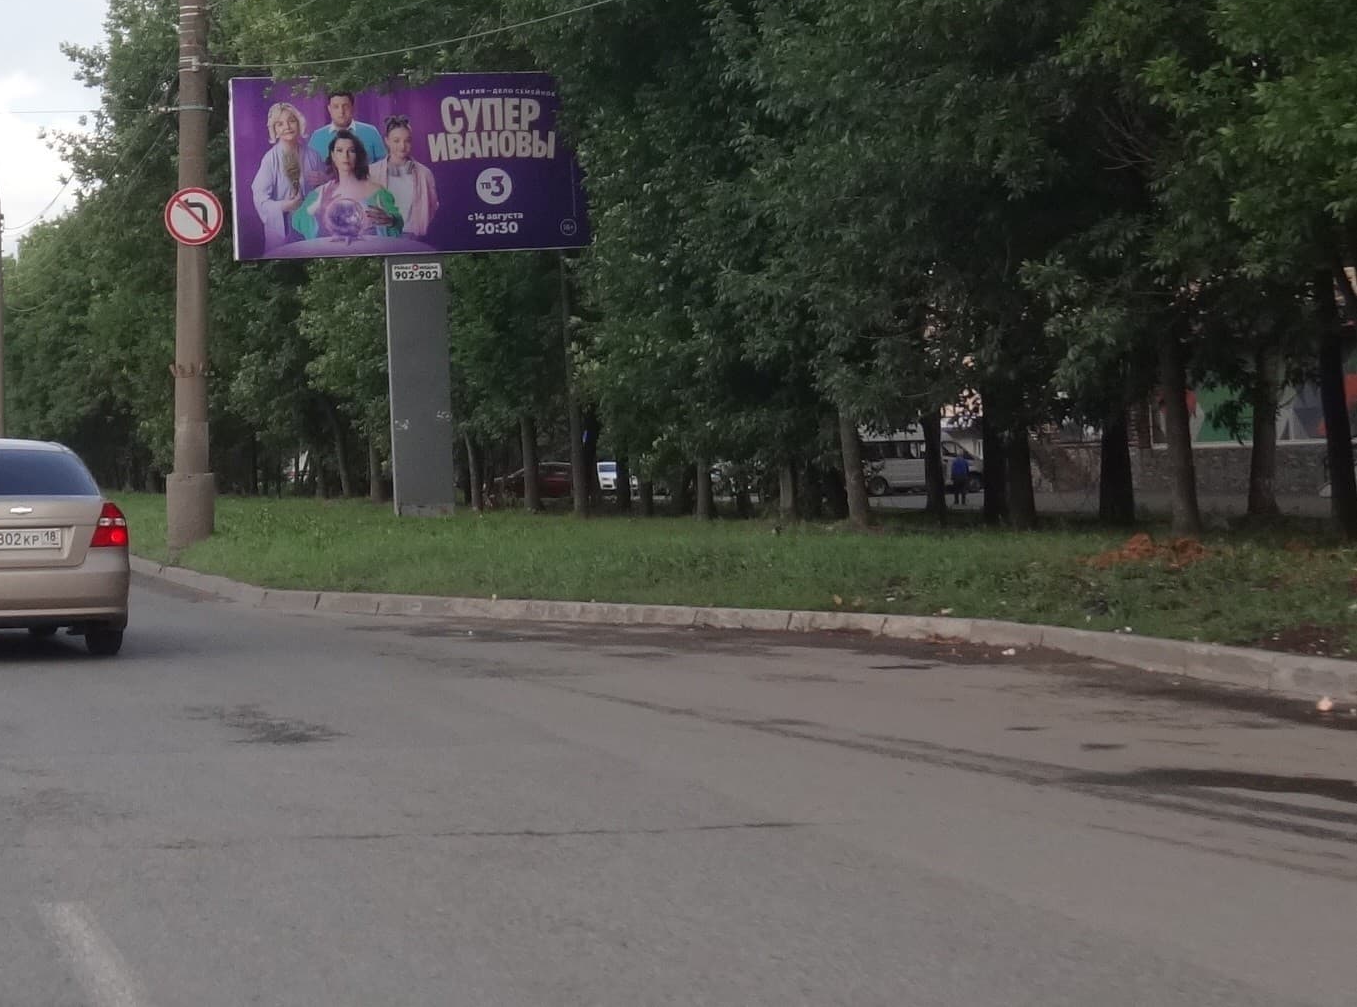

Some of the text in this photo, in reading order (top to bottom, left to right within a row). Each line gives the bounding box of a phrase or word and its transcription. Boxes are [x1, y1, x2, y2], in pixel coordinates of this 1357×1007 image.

[440, 96, 541, 133] СУПЕР
[427, 130, 556, 163] ИВАНОВЫ
[486, 212, 524, 221] августа
[475, 221, 519, 235] 20:30
[394, 270, 439, 280] 902-902
